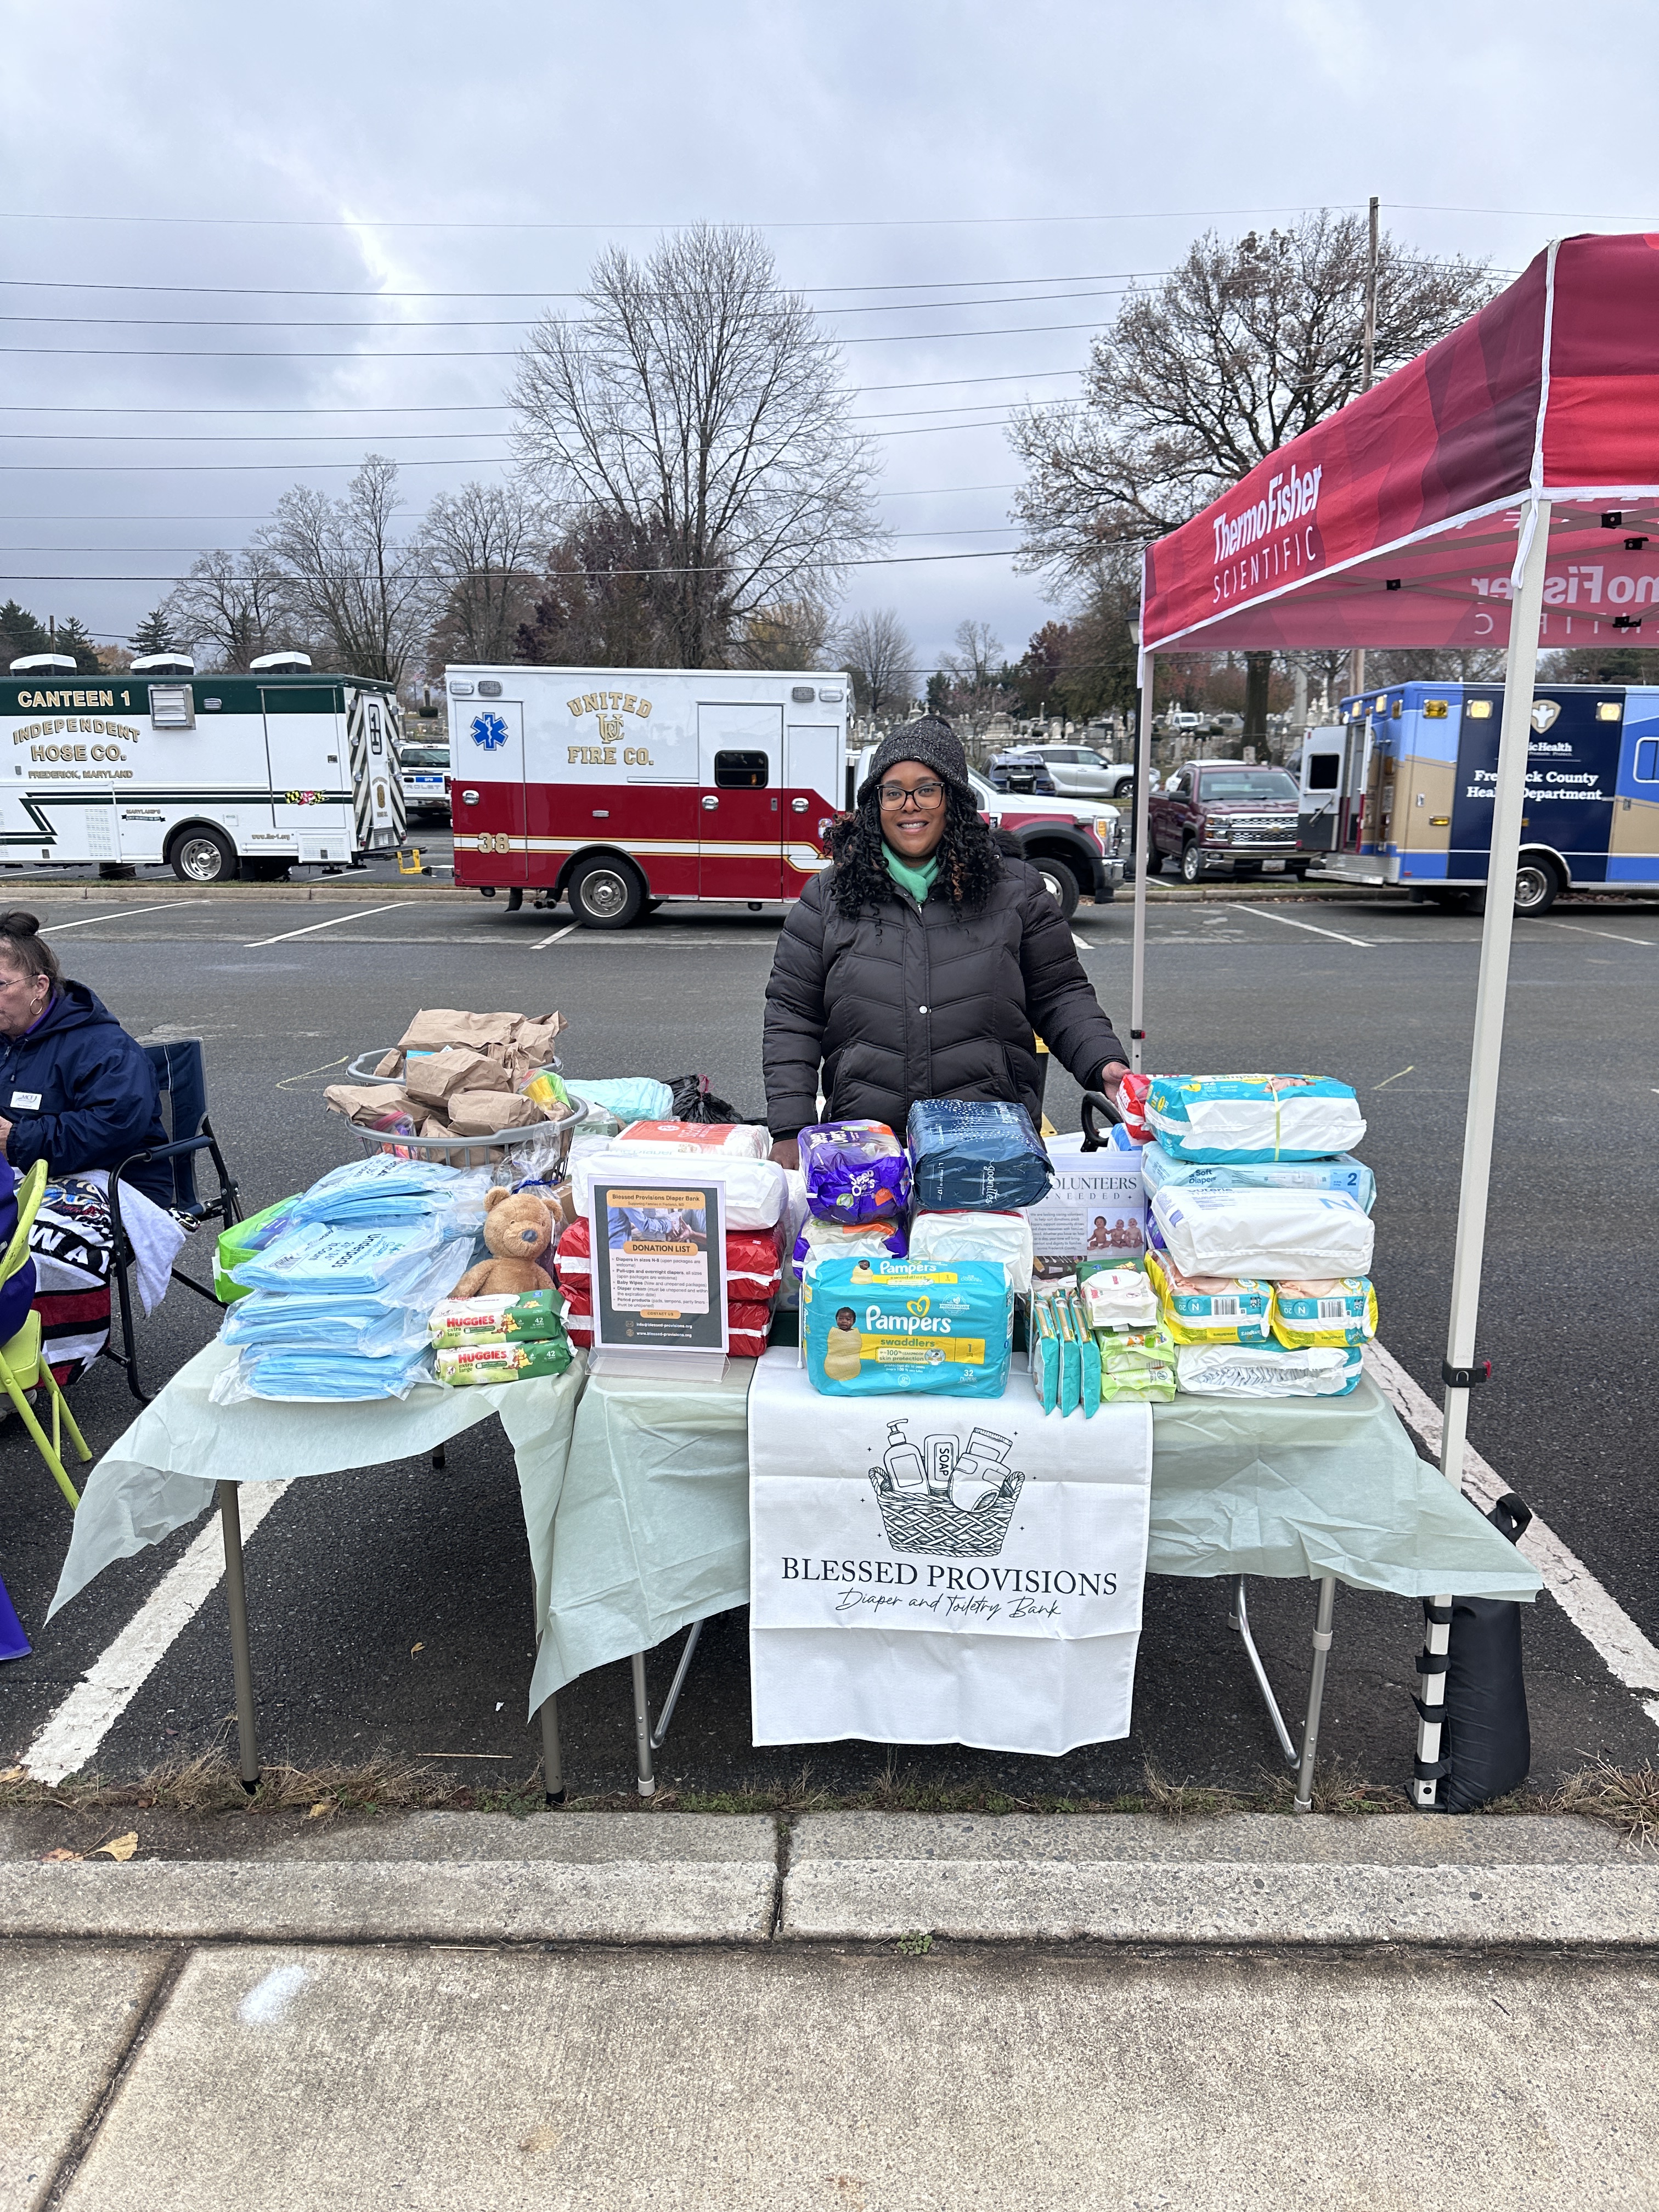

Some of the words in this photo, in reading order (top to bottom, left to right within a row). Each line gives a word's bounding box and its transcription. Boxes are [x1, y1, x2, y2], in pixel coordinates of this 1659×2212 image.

[1213, 464, 1322, 565] ThermoFisher
[1213, 526, 1316, 603] SCIENTIFIC
[18, 691, 114, 708] CANTEEN
[121, 691, 131, 707] 1
[567, 692, 653, 719] UNITED
[13, 718, 140, 745] INDEPENDENT
[31, 744, 88, 761] HOSE
[91, 744, 127, 761] CO.
[568, 746, 617, 765] FIRE
[624, 747, 654, 765] CO.
[28, 771, 81, 779] FREDERICK,
[83, 770, 133, 779] MARYLAND
[1545, 771, 1600, 787] County
[1466, 786, 1497, 798] Heal
[1523, 787, 1602, 802] Department
[477, 832, 510, 854] 38
[1052, 1177, 1137, 1190] OLUNTEERS
[1189, 1176, 1216, 1184] Diapers
[1347, 1172, 1357, 1186] 2
[331, 1234, 382, 1267] Underpads
[879, 1261, 937, 1274] Pampers
[1192, 1303, 1199, 1311] N
[1298, 1306, 1306, 1314] N
[447, 1316, 495, 1328] HUGGIES
[866, 1305, 952, 1335] Pampers
[881, 1338, 935, 1347] swaddlers
[967, 1344, 972, 1352] 1
[458, 1351, 507, 1364] HUGGIES
[938, 1448, 950, 1476] SOAP
[781, 1556, 918, 1586] BLESSED
[927, 1565, 1118, 1597] PROVISIONS
[834, 1587, 902, 1615] Diaper
[908, 1591, 940, 1610] and
[944, 1596, 1001, 1621] Toiletry
[1008, 1598, 1062, 1619] Bank
